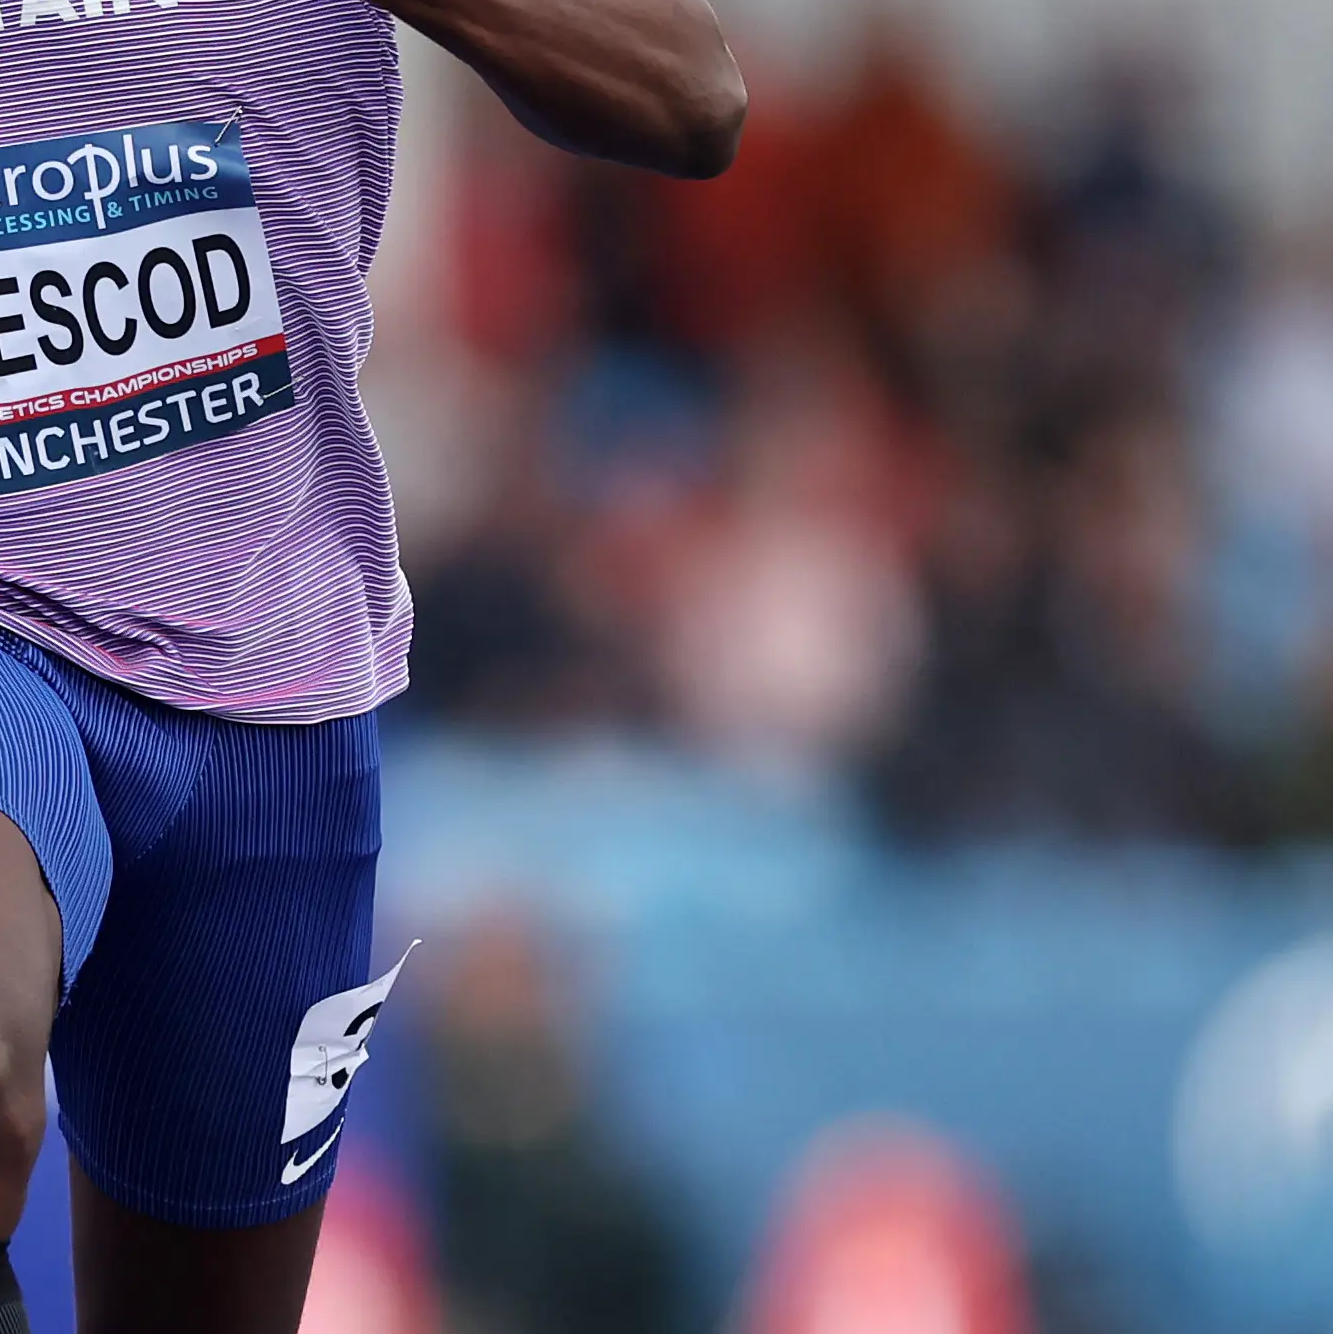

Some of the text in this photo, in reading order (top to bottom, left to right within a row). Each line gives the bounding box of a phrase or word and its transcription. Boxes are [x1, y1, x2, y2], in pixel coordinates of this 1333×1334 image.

[107, 201, 123, 218] &
[129, 186, 218, 212] TIMING
[70, 343, 258, 405] CHAMPIONSHIPS
